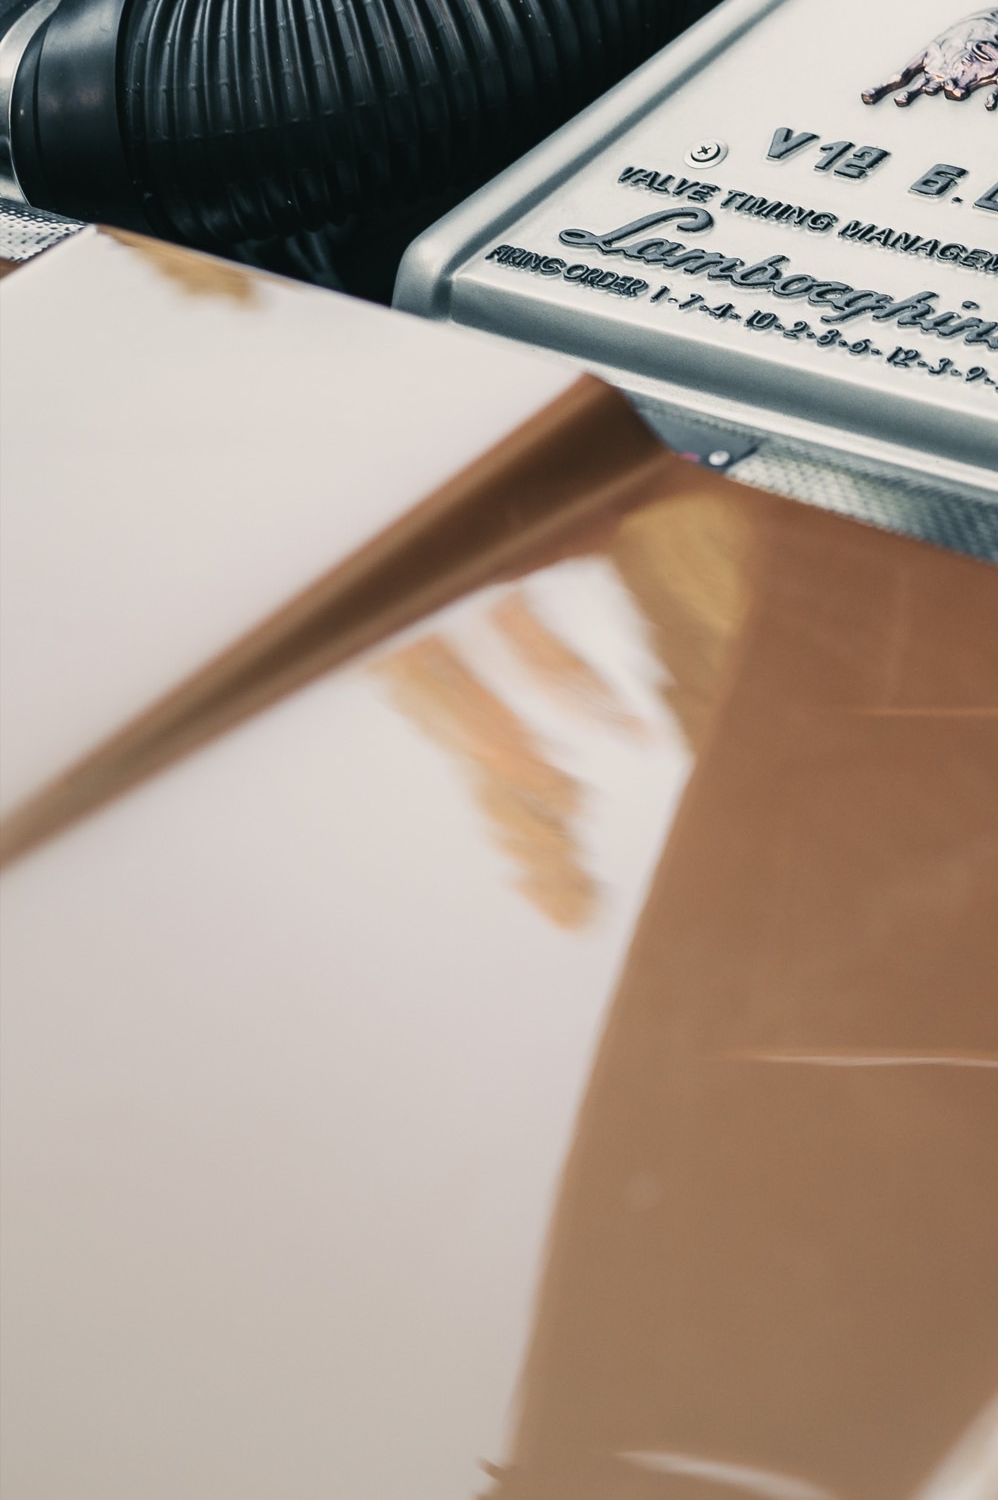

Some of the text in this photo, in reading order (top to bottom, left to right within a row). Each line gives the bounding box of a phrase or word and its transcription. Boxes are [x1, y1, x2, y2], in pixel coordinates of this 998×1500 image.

[617, 166, 721, 203] VALVE
[720, 190, 839, 231] TIMING
[485, 244, 566, 275] FIRING
[563, 263, 649, 298] ORDER
